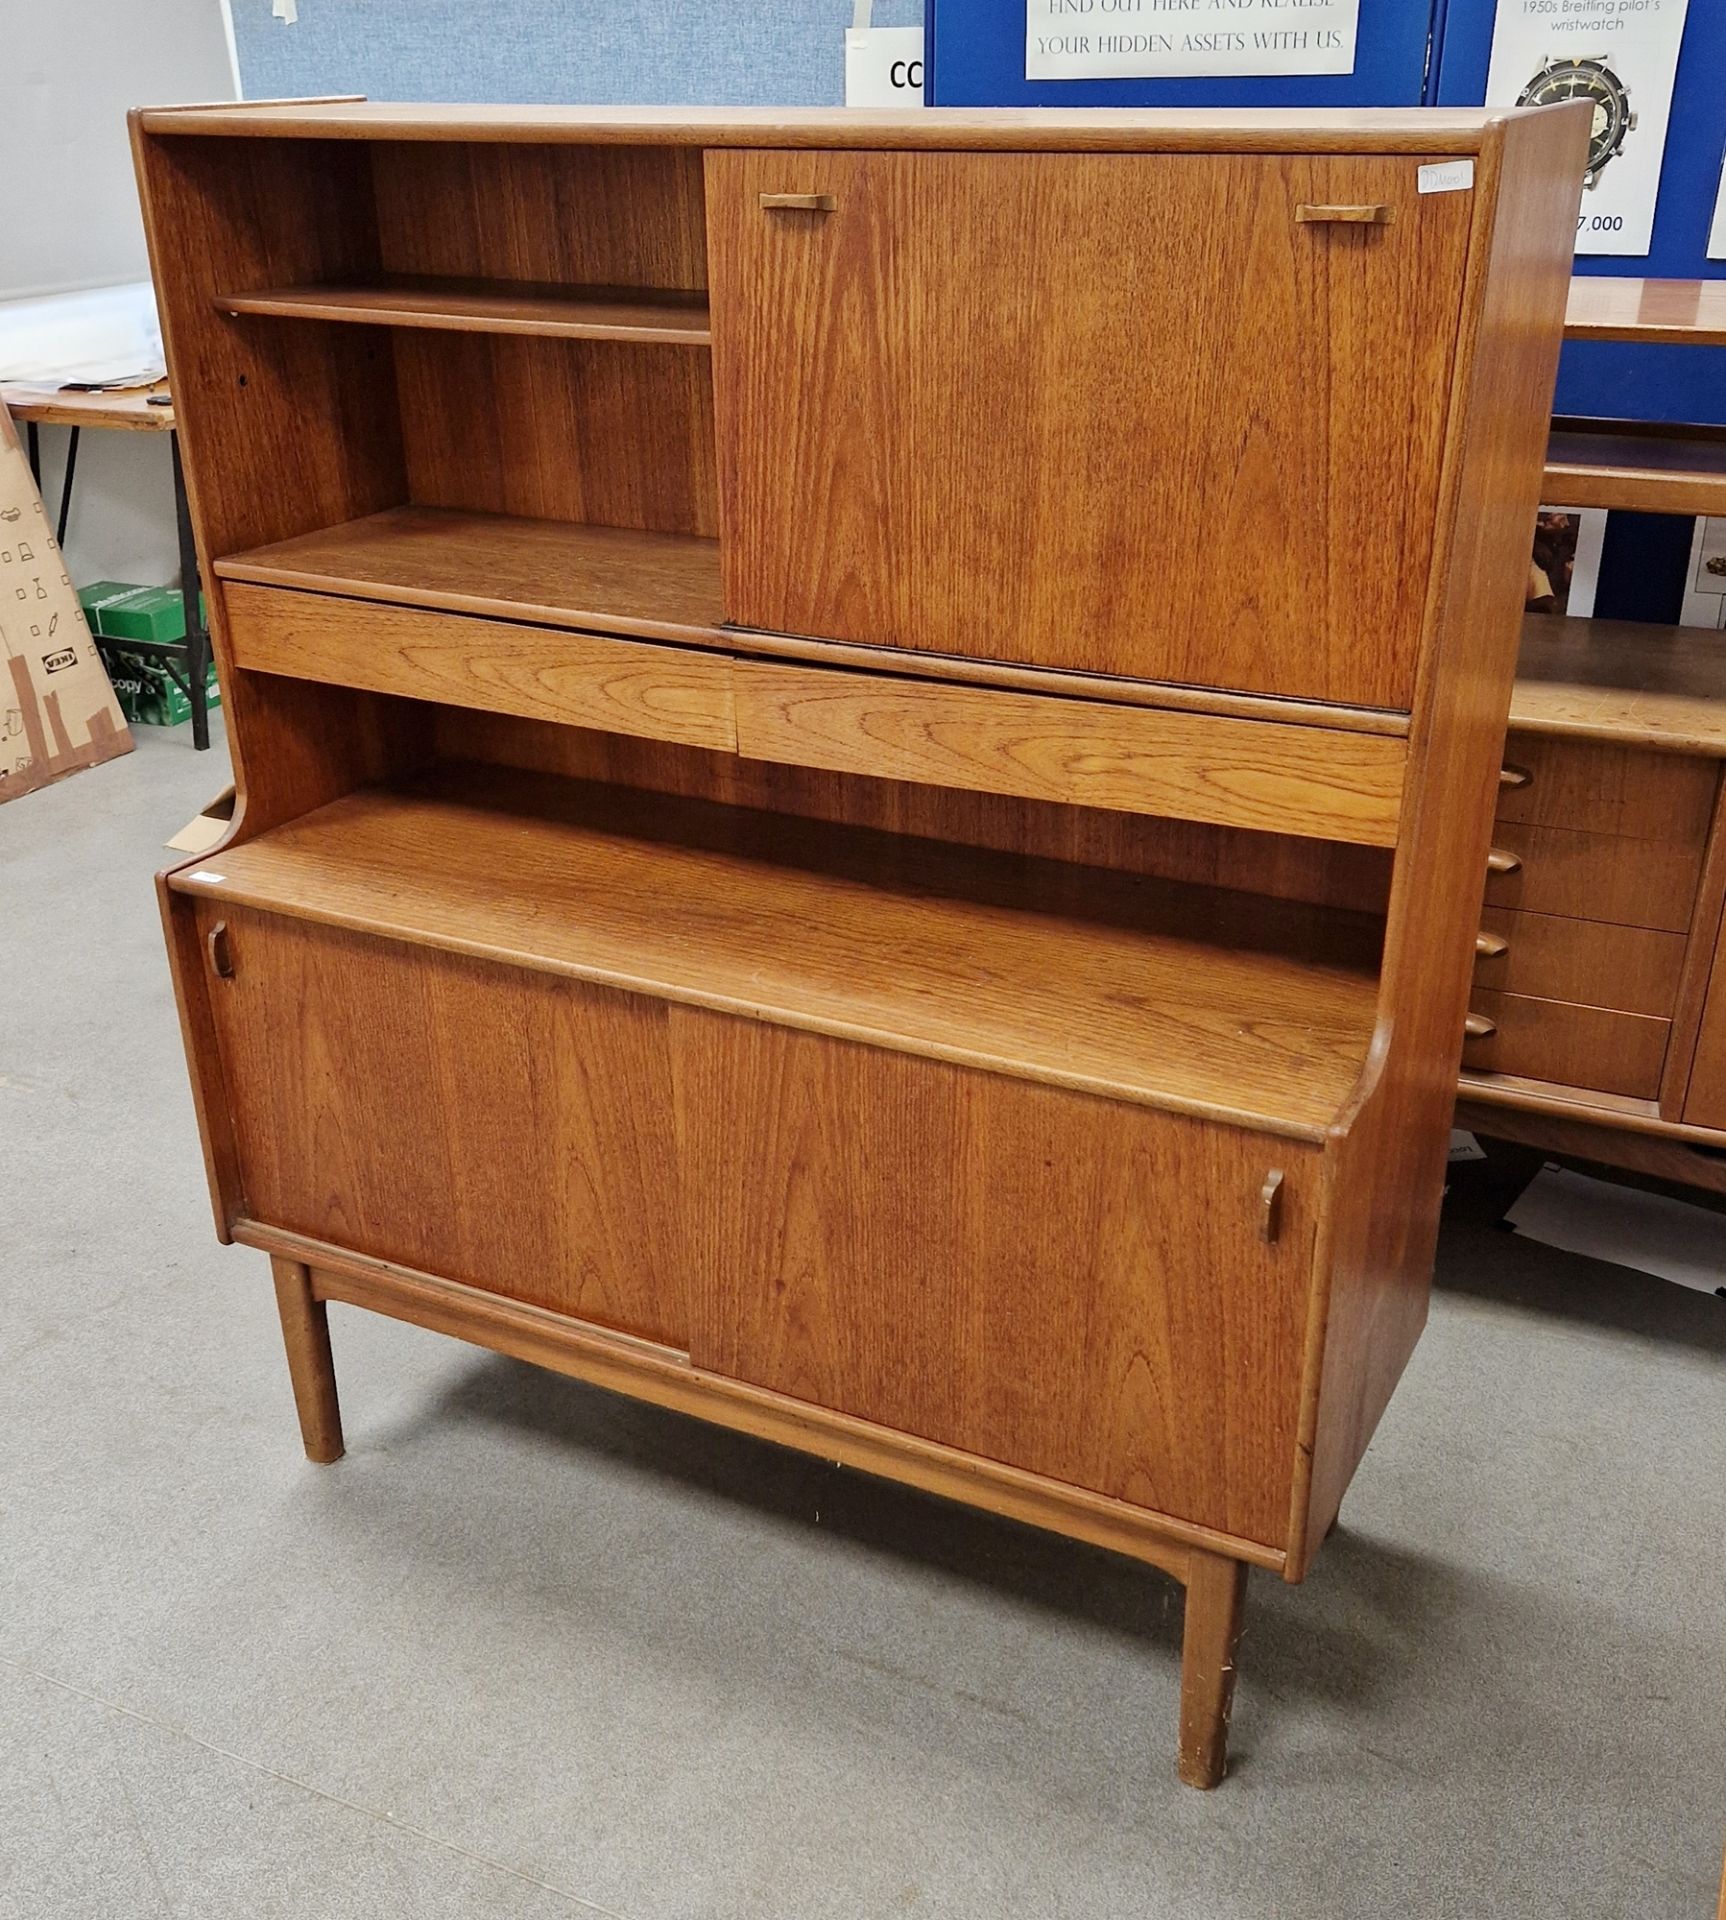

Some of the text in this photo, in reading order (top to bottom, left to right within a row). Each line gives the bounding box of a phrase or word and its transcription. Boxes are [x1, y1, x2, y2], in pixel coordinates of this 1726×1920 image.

[1523, 0, 1558, 13] 1950s
[1561, 0, 1615, 14] Breitling
[1550, 18, 1624, 31] wristwatch
[1038, 30, 1344, 54] YOUR HIDDEN ASSETS WITH US.
